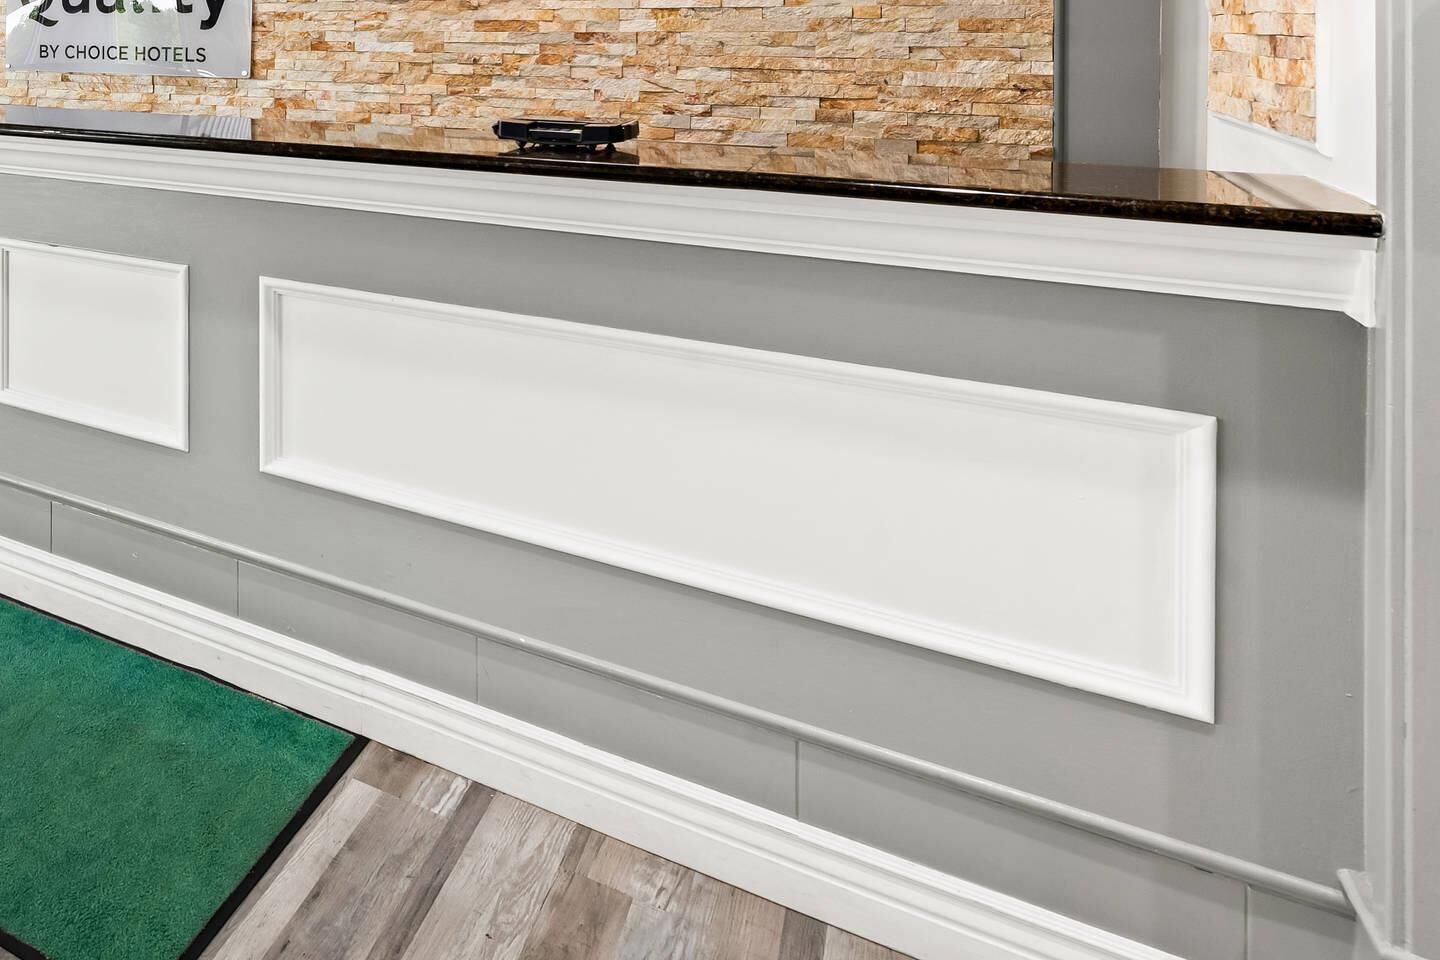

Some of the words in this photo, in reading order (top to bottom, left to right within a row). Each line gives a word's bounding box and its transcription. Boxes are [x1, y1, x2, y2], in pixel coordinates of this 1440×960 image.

[39, 44, 58, 60] BY
[65, 45, 128, 61] CHOICE
[135, 46, 206, 63] HOTELS
